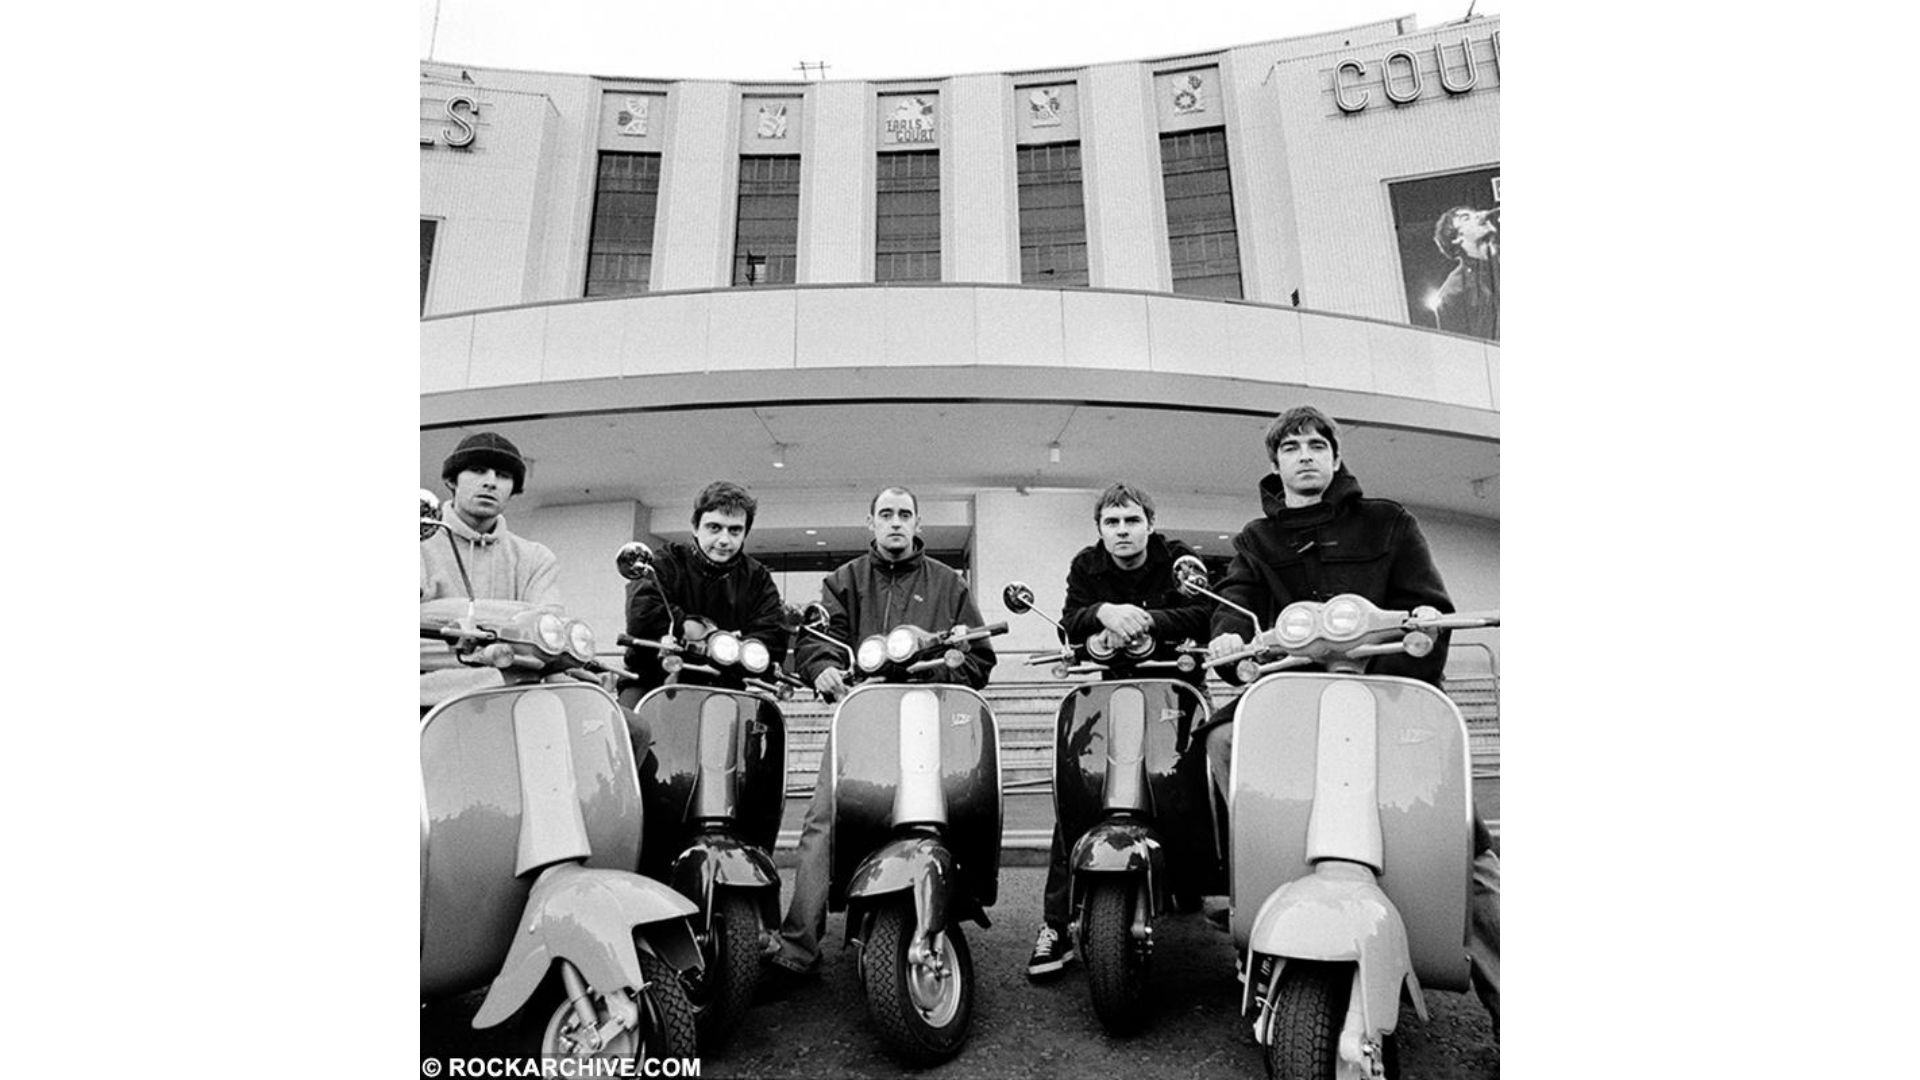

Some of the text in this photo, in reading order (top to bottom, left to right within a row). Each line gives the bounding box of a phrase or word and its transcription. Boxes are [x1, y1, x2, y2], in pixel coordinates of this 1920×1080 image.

[1334, 30, 1500, 113] COU
[420, 94, 478, 149] S
[896, 128, 935, 143] COURT
